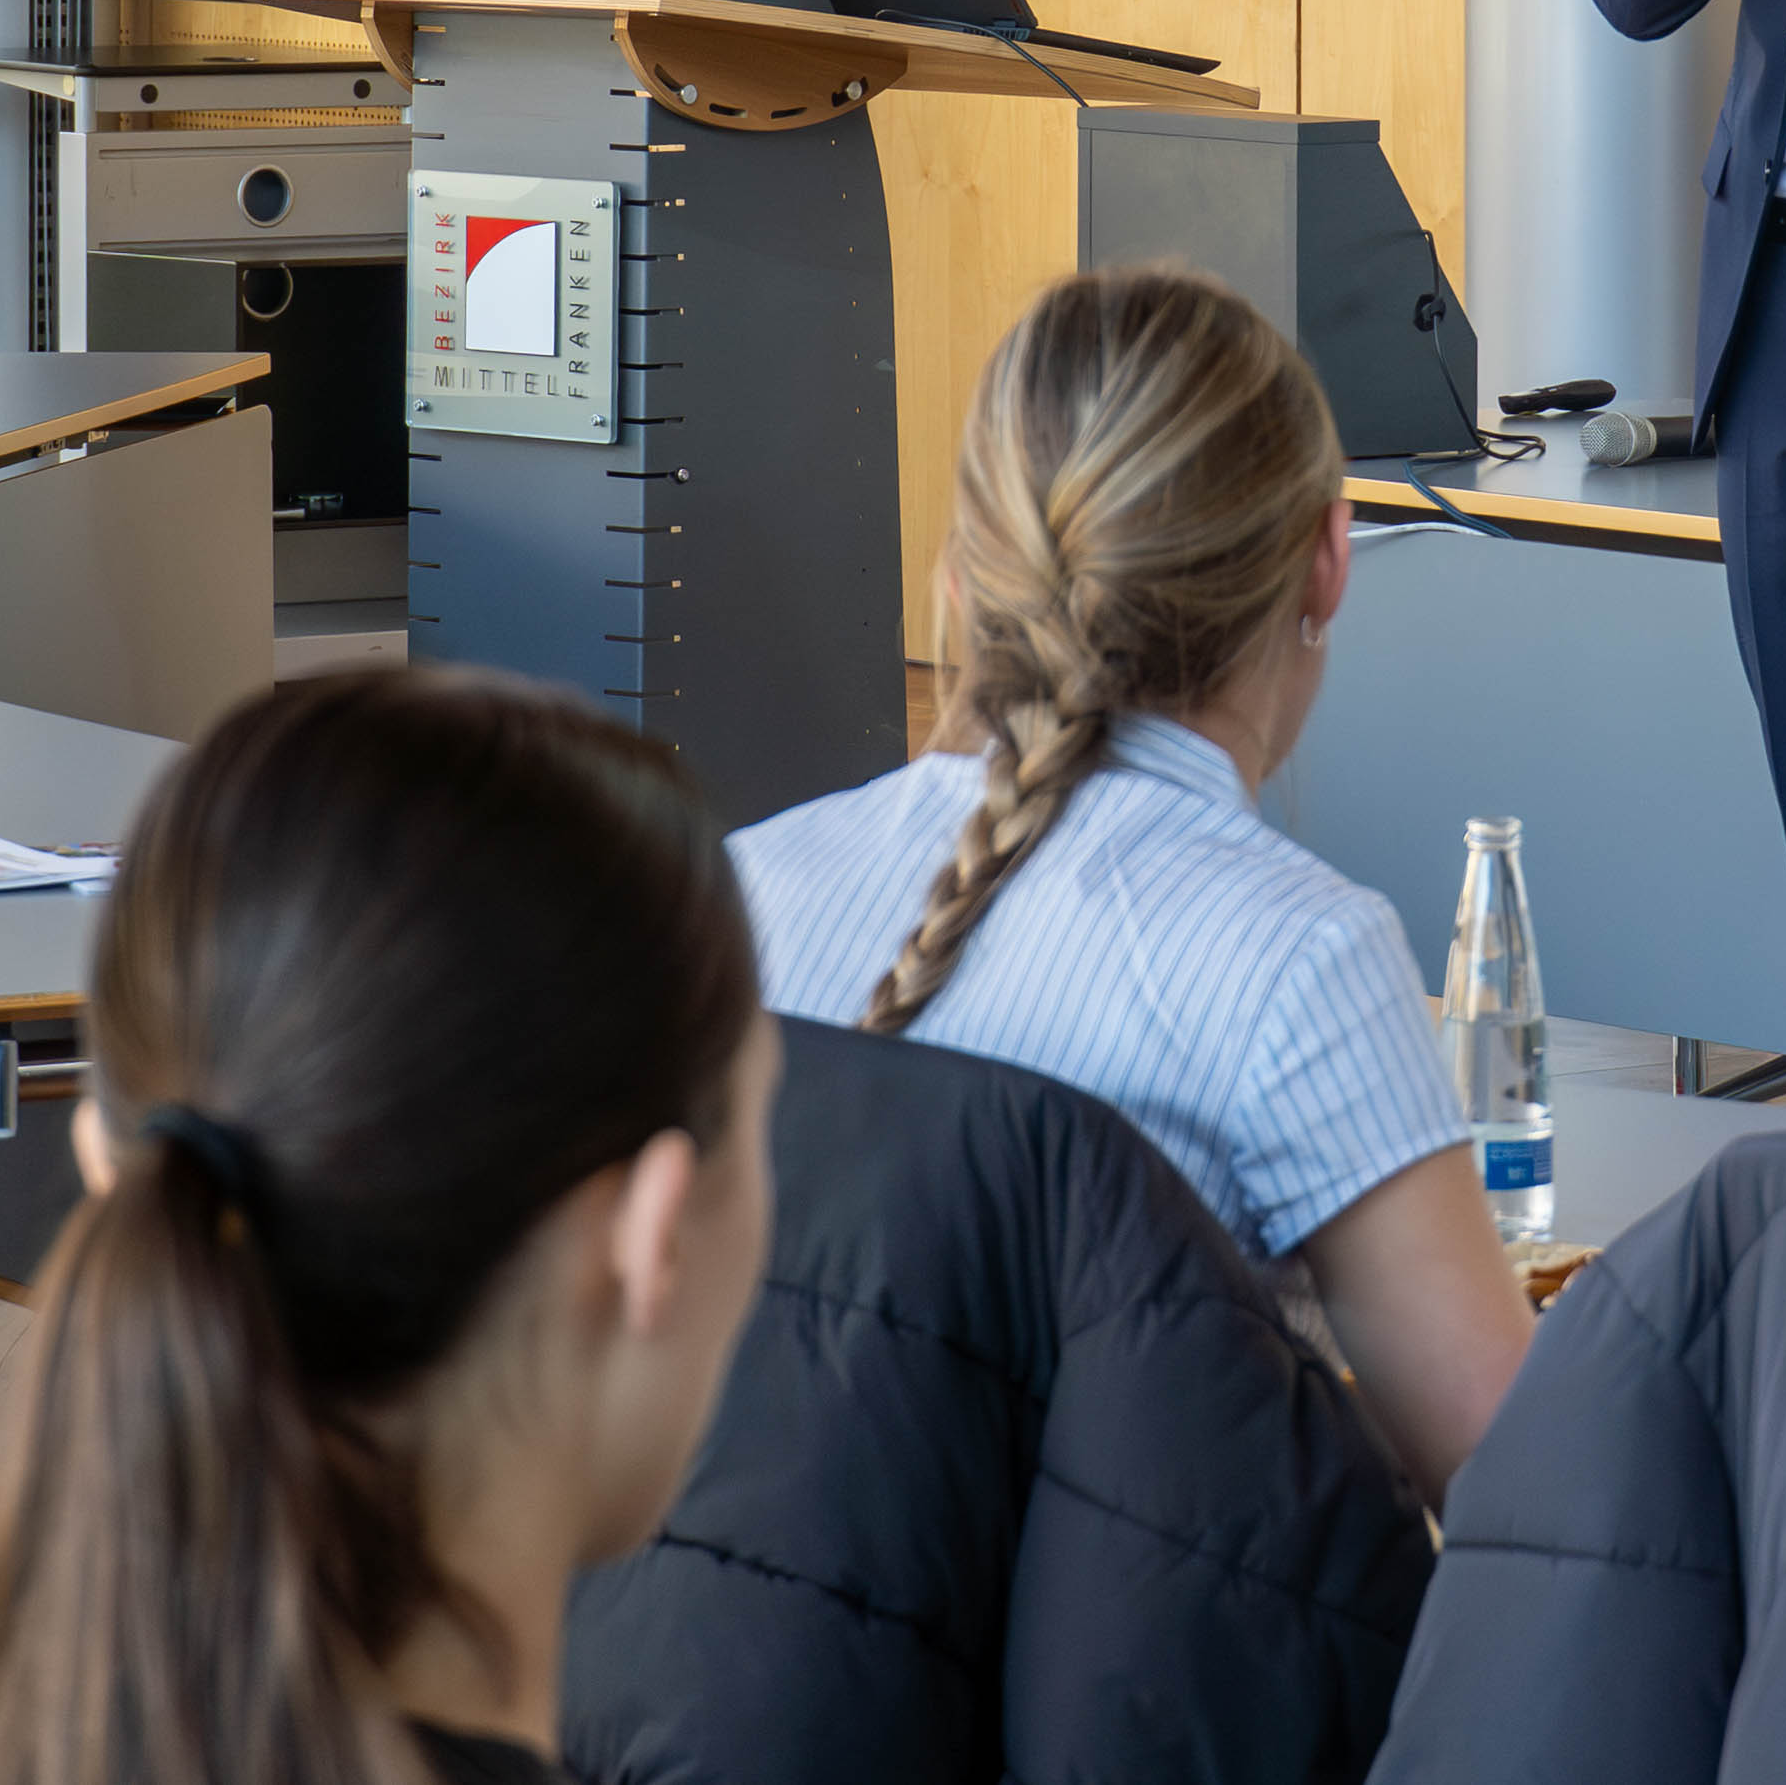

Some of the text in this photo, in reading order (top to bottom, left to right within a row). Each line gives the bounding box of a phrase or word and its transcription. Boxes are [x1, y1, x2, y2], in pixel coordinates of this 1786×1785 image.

[434, 213, 452, 351] BEZIRK
[568, 219, 586, 399] FRANKEN
[434, 365, 558, 396] MITTEL
